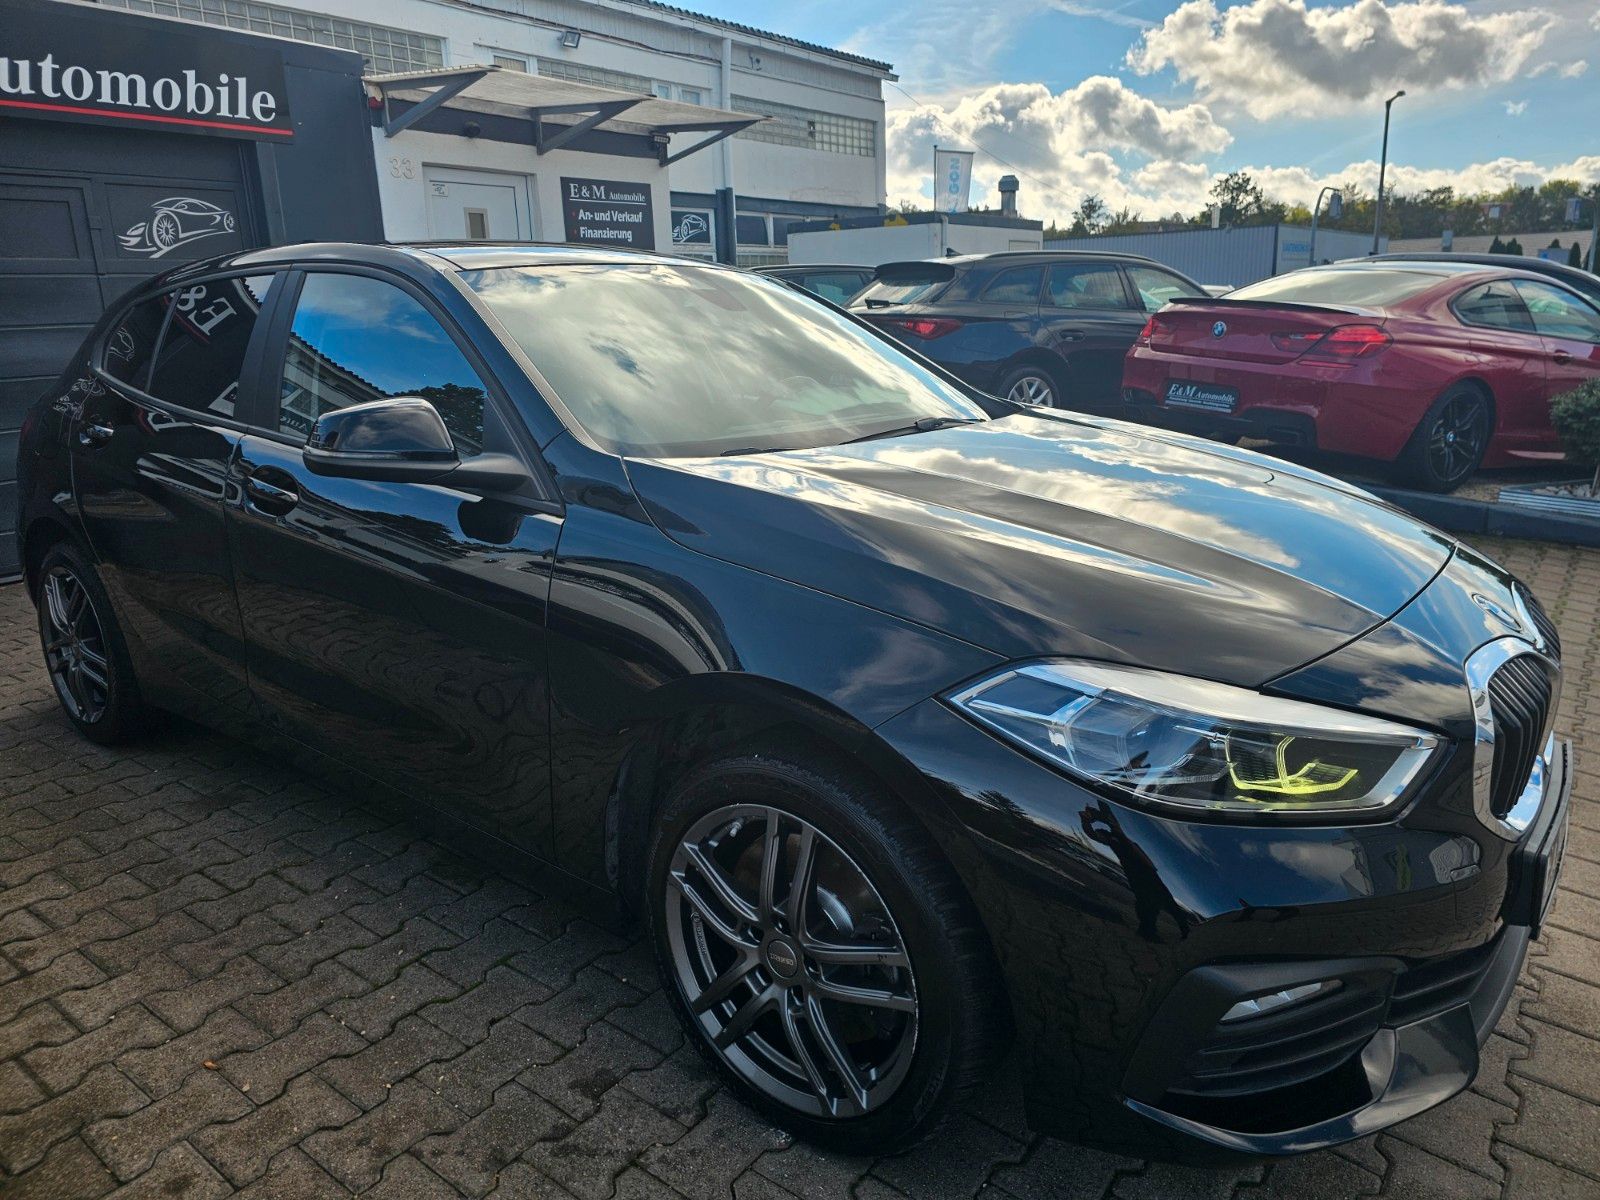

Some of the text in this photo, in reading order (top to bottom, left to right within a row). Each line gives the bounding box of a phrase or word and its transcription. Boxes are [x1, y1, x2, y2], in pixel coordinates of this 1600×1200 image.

[389, 157, 416, 180] 33
[609, 192, 646, 202] Automobile
[578, 208, 643, 222] An- und Verkauf
[580, 226, 633, 242] Finanzierung
[1195, 391, 1235, 402] Automobile
